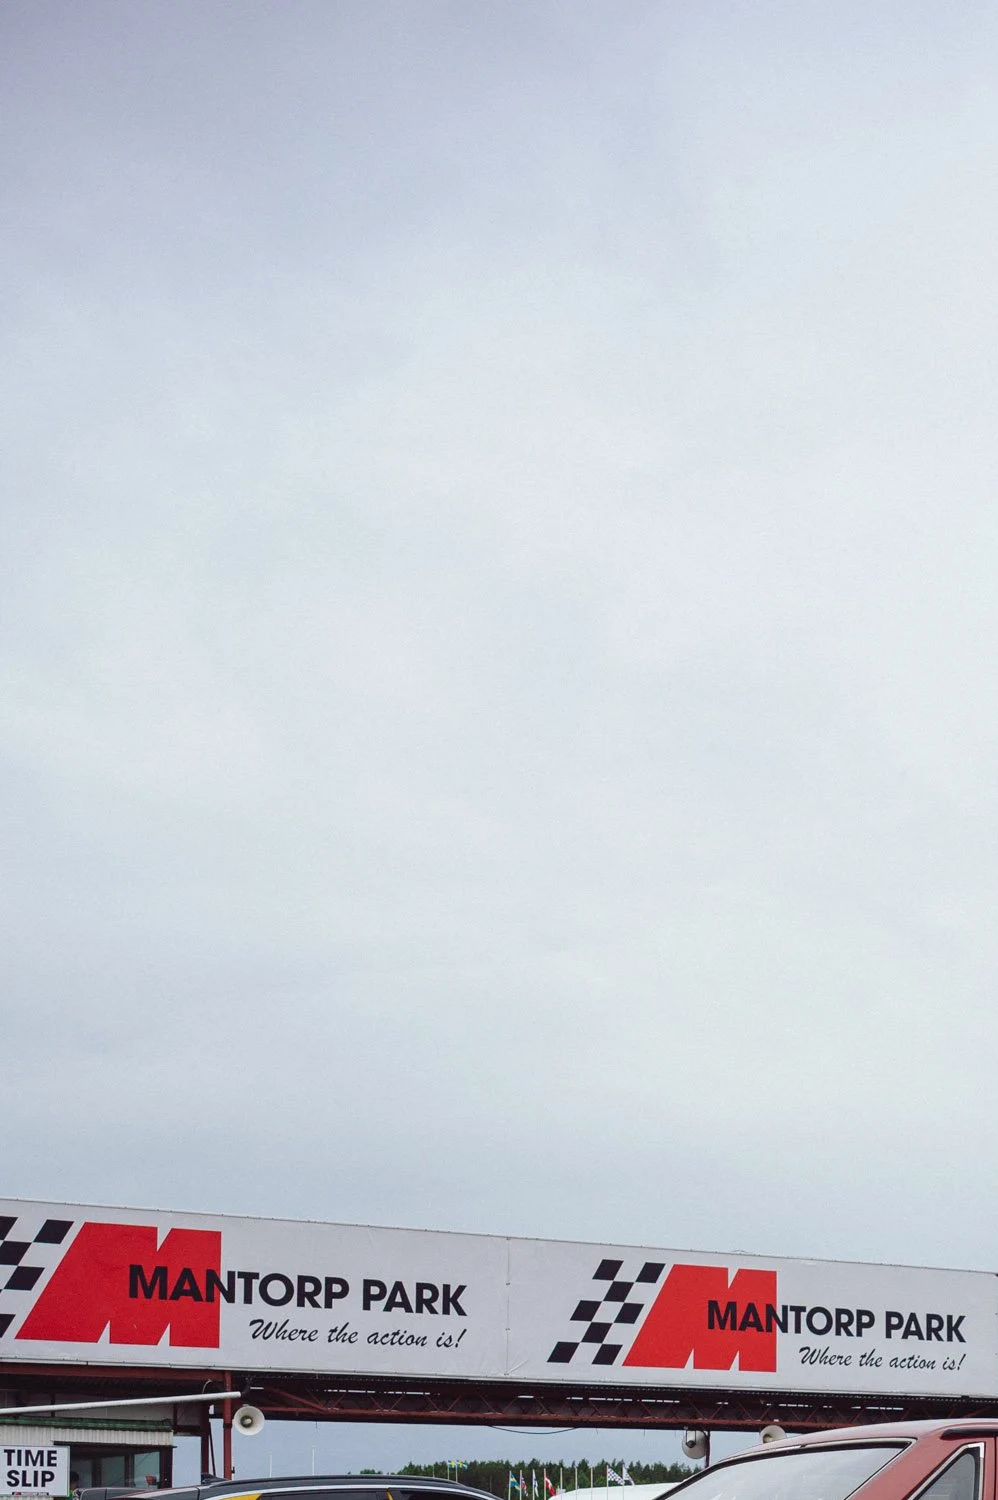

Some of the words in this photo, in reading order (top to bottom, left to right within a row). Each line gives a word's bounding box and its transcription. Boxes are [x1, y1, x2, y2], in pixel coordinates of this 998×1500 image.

[128, 1264, 349, 1310] MANTORP
[363, 1279, 468, 1317] PARK
[249, 1318, 319, 1343] Where
[327, 1322, 360, 1345] the
[367, 1326, 431, 1349] action
[435, 1328, 467, 1349] is!
[707, 1299, 875, 1338] MANTORP
[885, 1310, 967, 1343] PARK
[799, 1346, 852, 1368] Where
[859, 1347, 884, 1369] the
[889, 1351, 936, 1371] action
[942, 1352, 966, 1372] is!
[4, 1449, 57, 1467] TIME
[7, 1469, 55, 1487] SLIP
